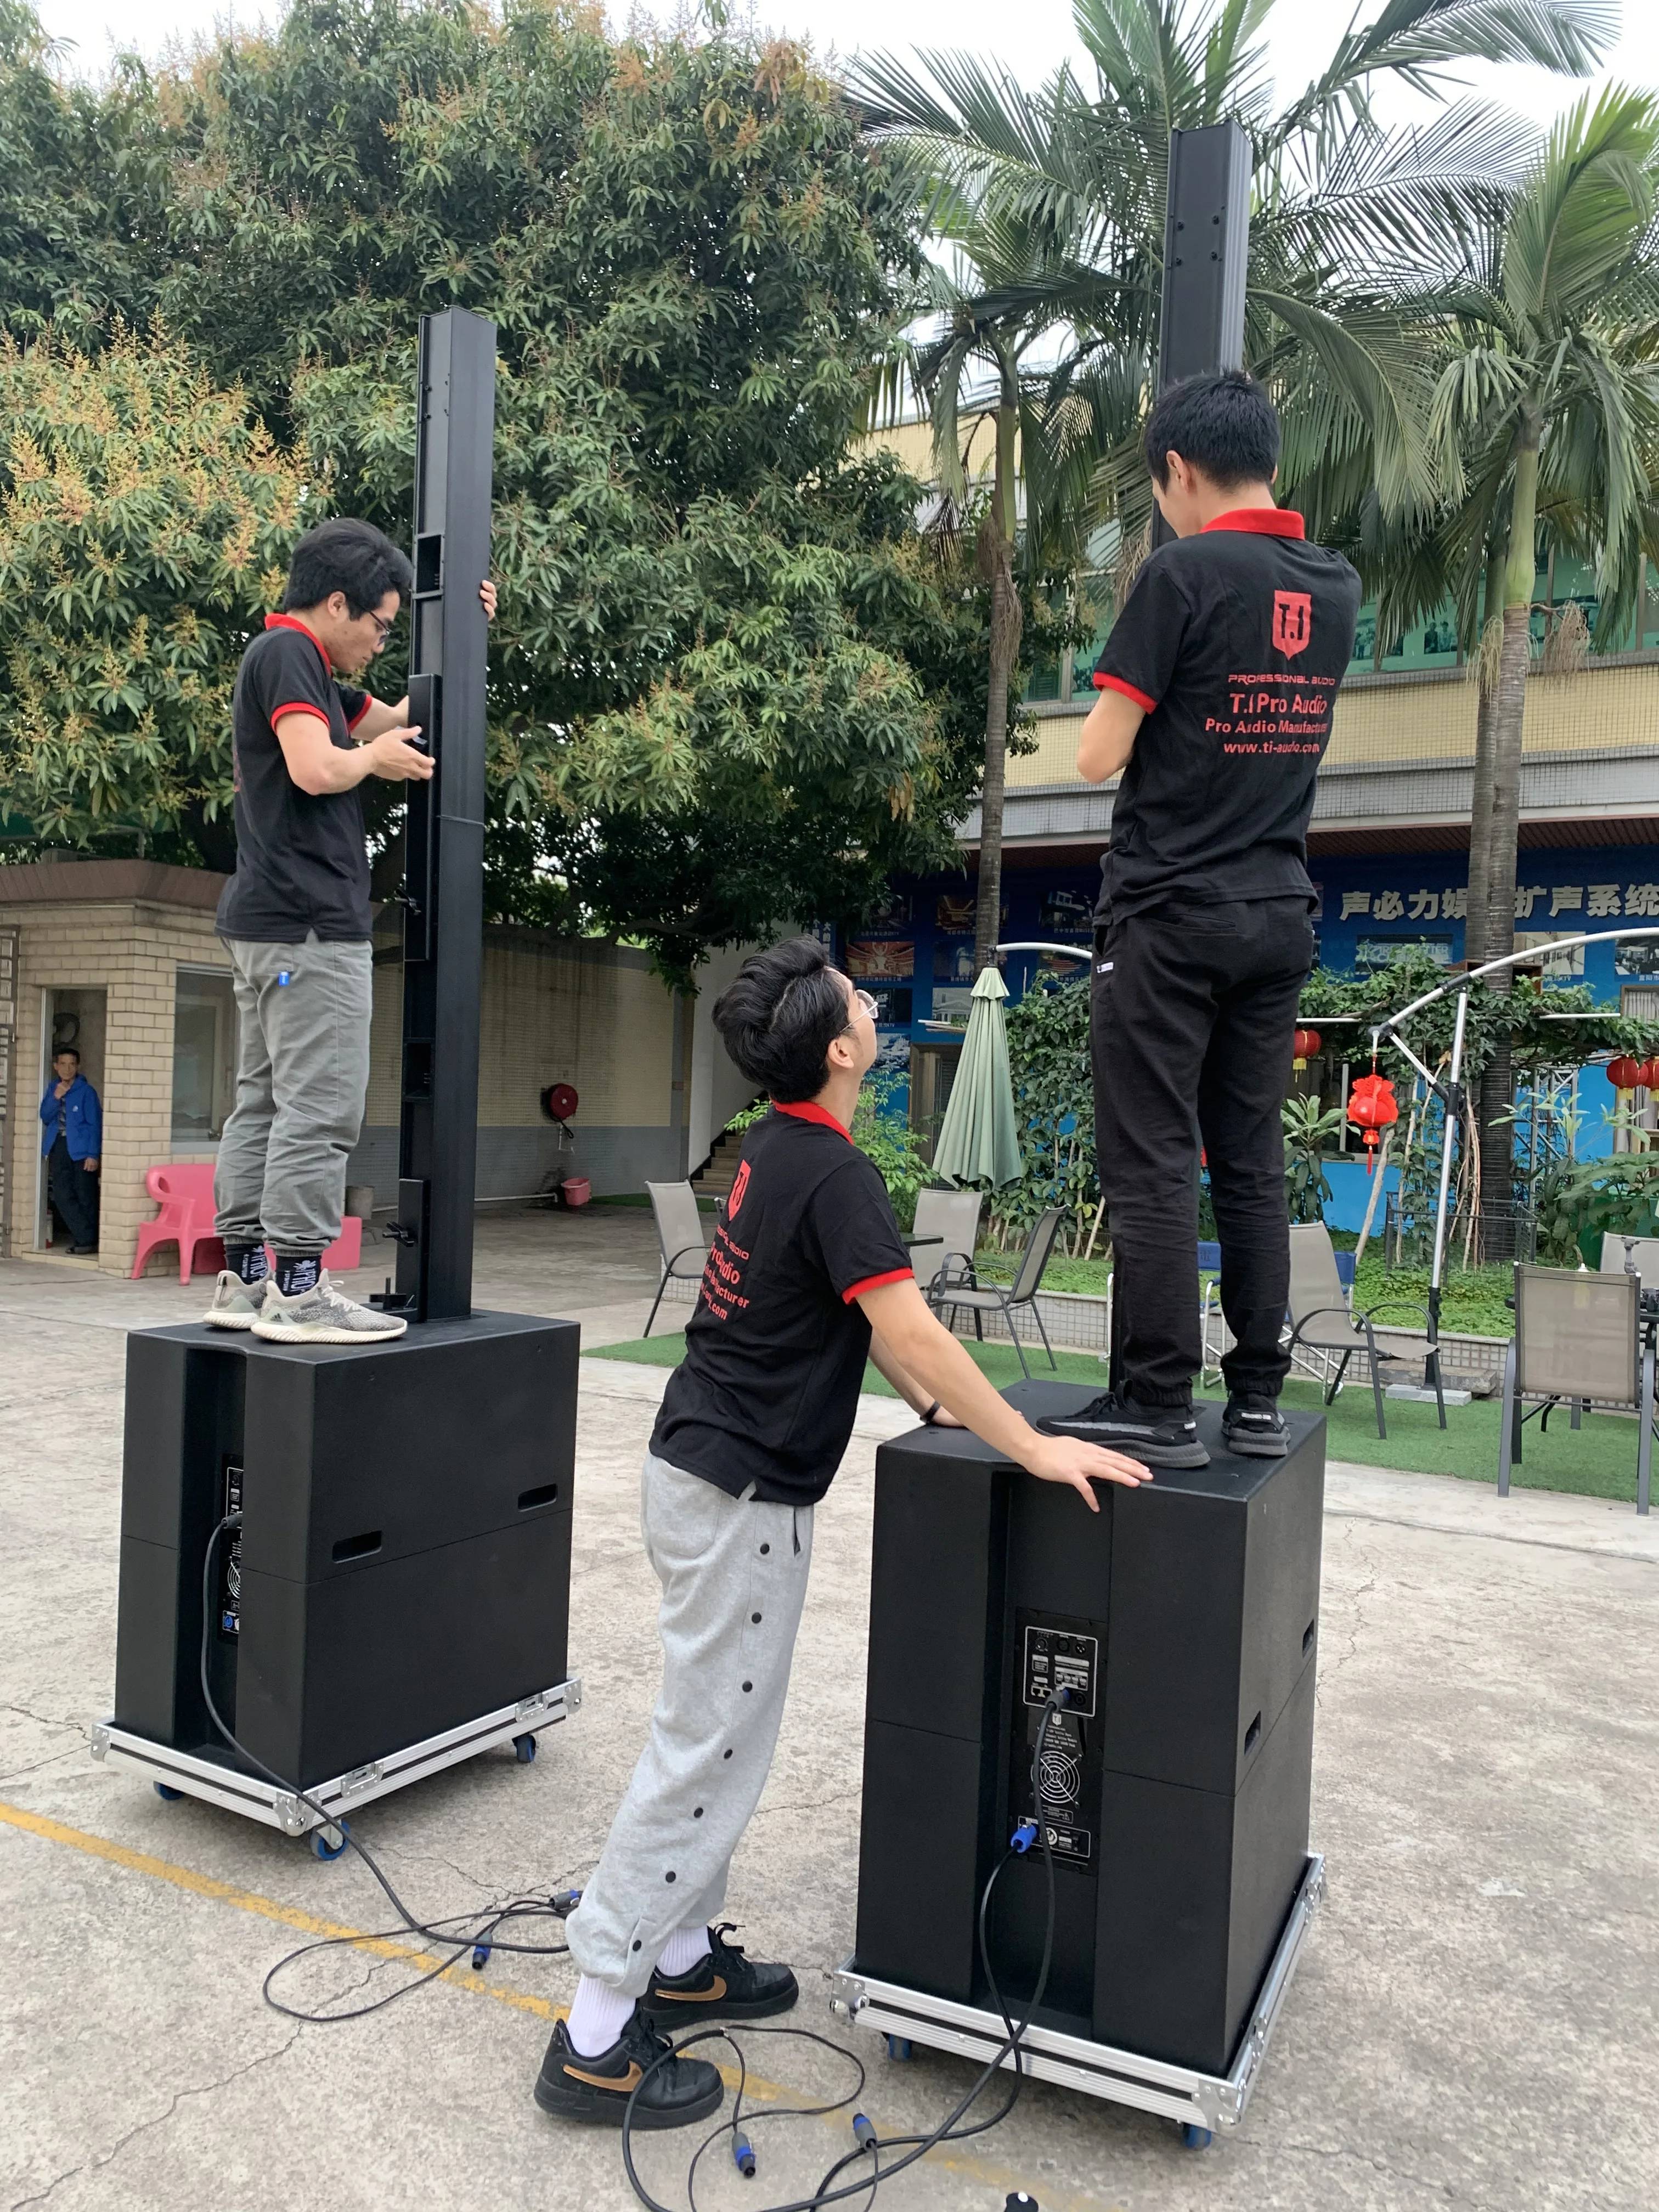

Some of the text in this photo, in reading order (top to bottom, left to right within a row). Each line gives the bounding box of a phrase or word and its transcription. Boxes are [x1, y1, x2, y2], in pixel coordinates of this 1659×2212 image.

[1279, 603, 1304, 641] T.I
[1256, 692, 1288, 713] Pro
[1291, 693, 1328, 714] Audio
[1205, 717, 1232, 733] Pro
[1223, 740, 1320, 754] www.ti-audio.com
[1339, 883, 1659, 921] 声必力娱扩声系统
